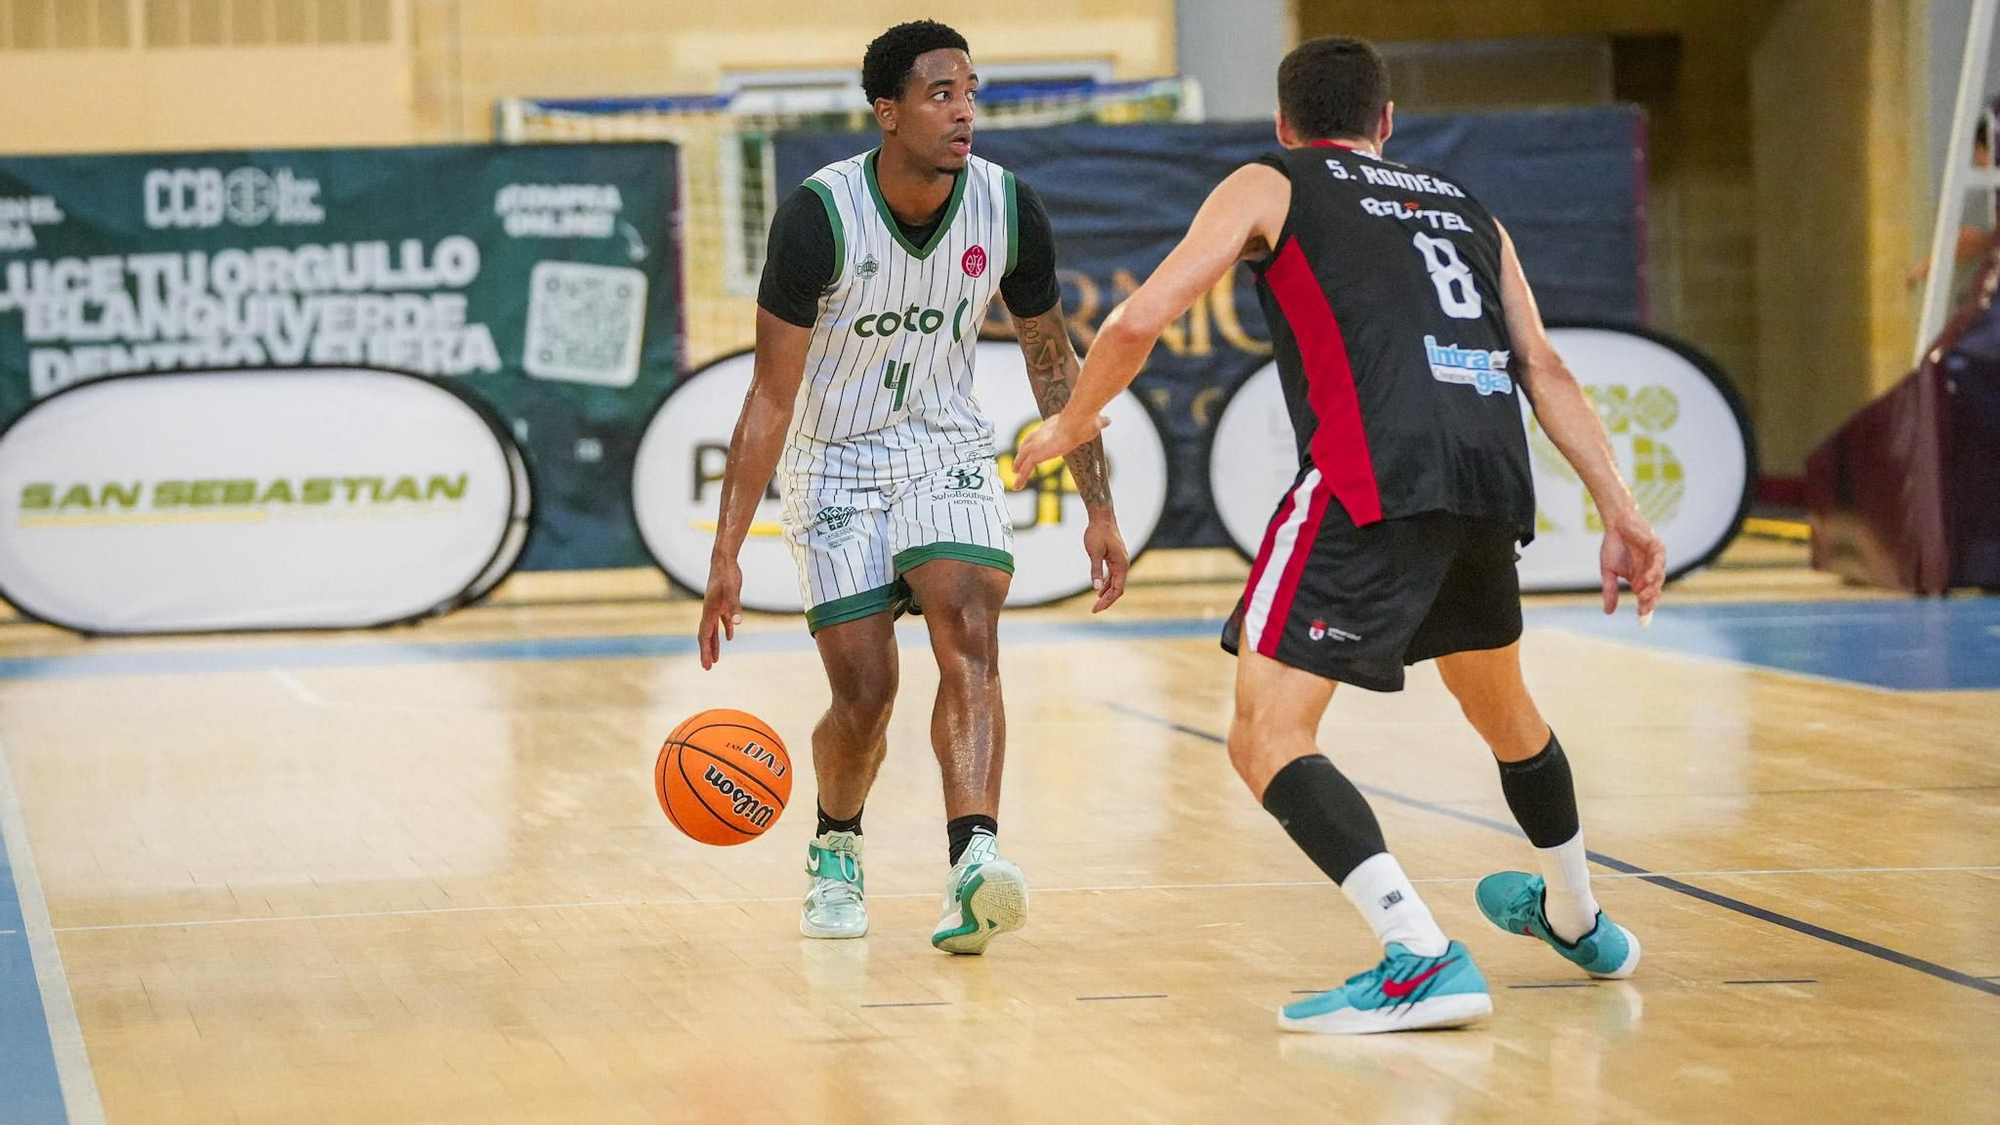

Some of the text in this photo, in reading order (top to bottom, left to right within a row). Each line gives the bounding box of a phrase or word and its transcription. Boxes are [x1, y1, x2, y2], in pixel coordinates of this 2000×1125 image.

[127, 249, 210, 303] TU
[210, 234, 481, 294] ORGULLO
[1413, 231, 1483, 319] 8
[24, 291, 468, 341] BLANQUIVERDE
[854, 301, 945, 339] coto
[884, 359, 911, 412] 4
[1475, 371, 1512, 395] gas
[20, 473, 469, 509] SAN SEBASTIAN
[704, 764, 775, 828] Wilson
